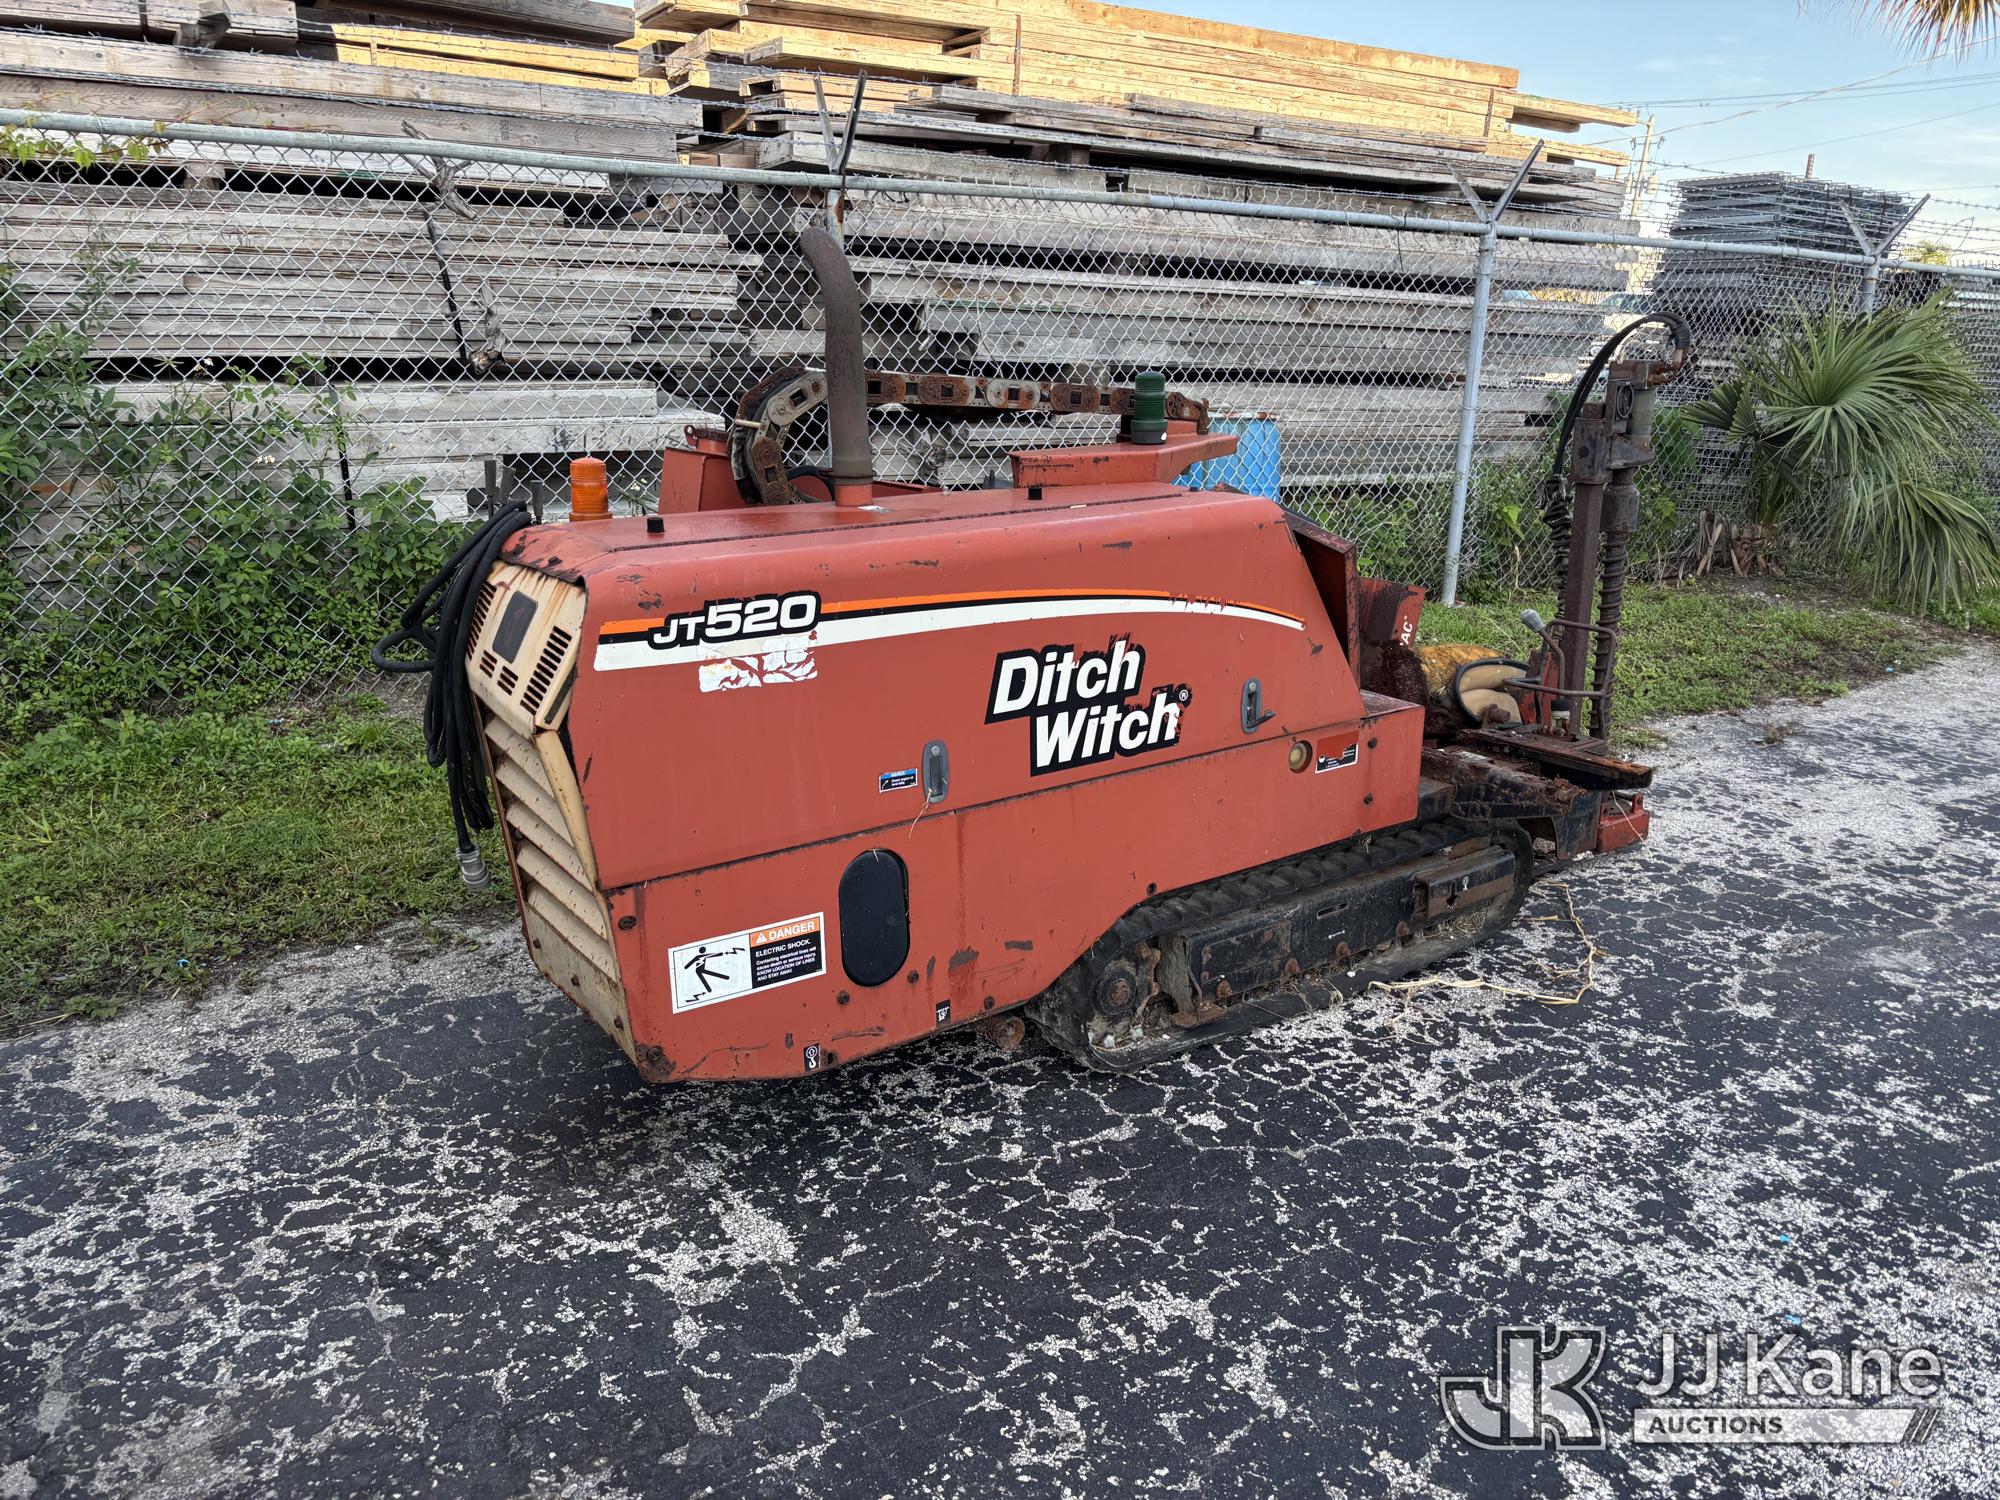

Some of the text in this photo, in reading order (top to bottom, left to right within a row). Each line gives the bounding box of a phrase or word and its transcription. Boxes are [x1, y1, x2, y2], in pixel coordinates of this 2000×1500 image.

[653, 594, 817, 644] JT520
[993, 640, 1140, 714] Ditch
[768, 921, 815, 940] DANGER
[755, 938, 811, 957] ELECTRIC SHOCK.
[756, 968, 771, 976] KNOW
[772, 962, 795, 972] LOCATION
[768, 971, 780, 979] STAY
